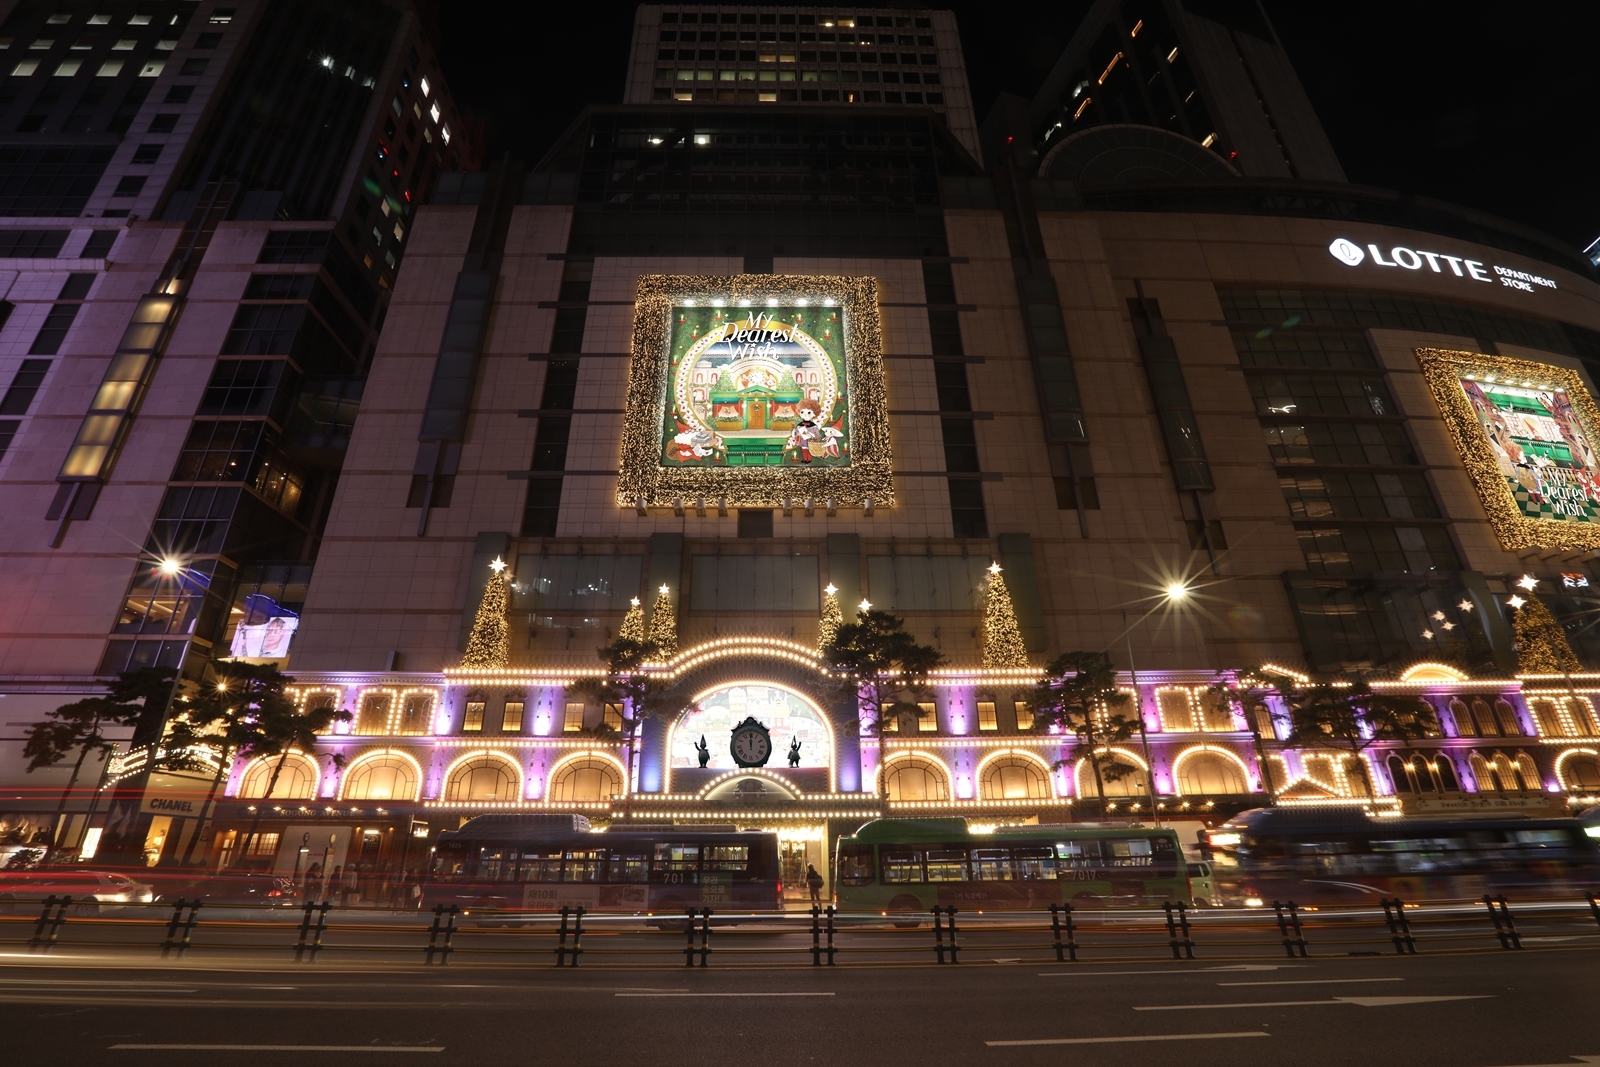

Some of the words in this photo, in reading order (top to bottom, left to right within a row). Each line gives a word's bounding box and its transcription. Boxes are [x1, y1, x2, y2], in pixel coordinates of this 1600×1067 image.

[1367, 243, 1492, 282] LOTTE
[1493, 265, 1557, 290] DEPARTMENT
[1500, 276, 1534, 293] STORE
[744, 310, 774, 330] My
[717, 321, 798, 343] Dearest
[727, 338, 780, 361] Wish
[1547, 468, 1566, 487] My
[1537, 478, 1589, 502] Dearest
[1547, 495, 1588, 517] Wish
[150, 798, 193, 812] CHANEL
[280, 809, 316, 817] SOGONG
[321, 809, 355, 817] AVENUE
[663, 873, 685, 884] 701
[702, 876, 718, 884] 우리
[1071, 869, 1096, 881] 7017
[528, 889, 557, 900] 제10회
[702, 885, 725, 894] 숲으로
[702, 894, 720, 903] 가자!
